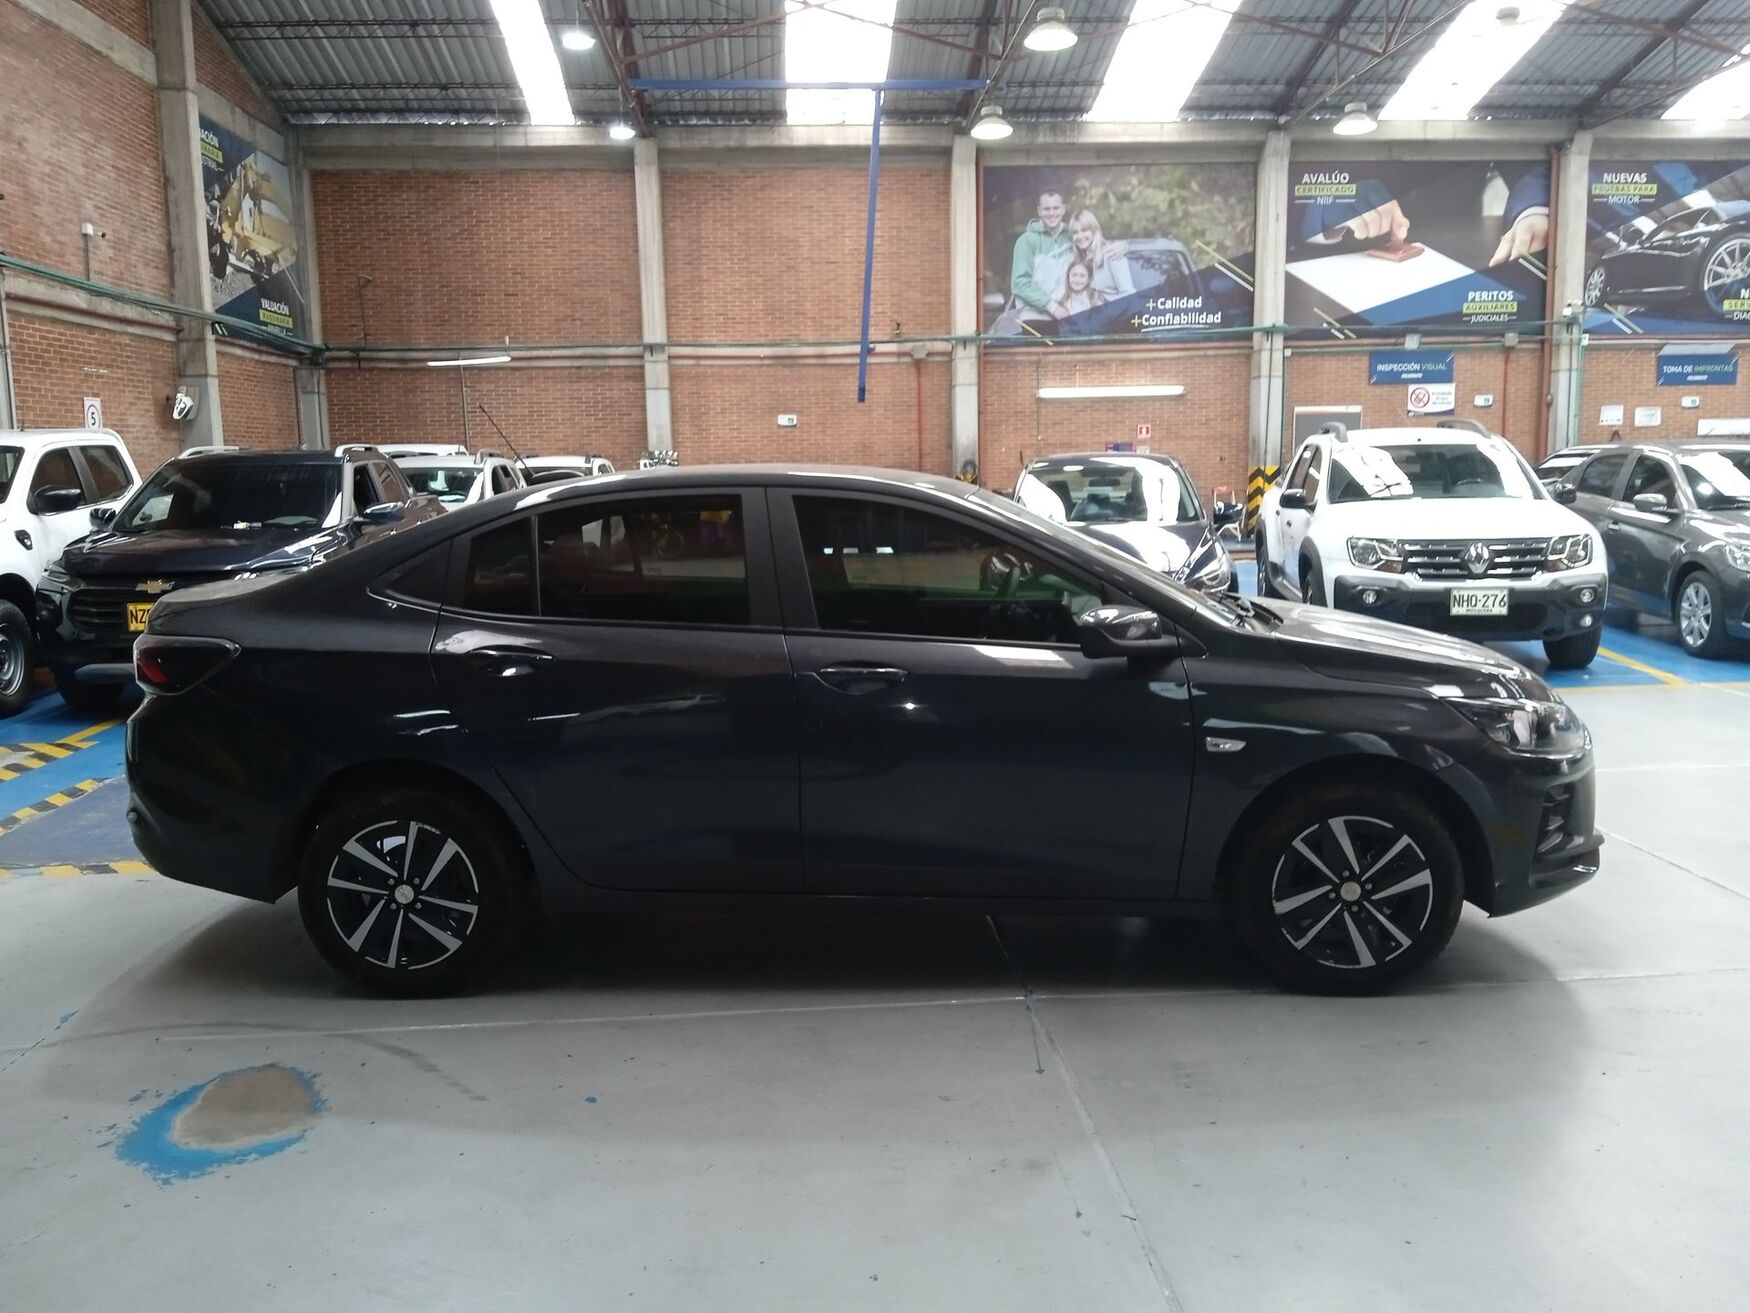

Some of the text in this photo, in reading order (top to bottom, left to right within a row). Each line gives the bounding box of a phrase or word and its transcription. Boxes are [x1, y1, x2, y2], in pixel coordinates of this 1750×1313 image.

[1301, 169, 1350, 185] AVALÚO
[1602, 171, 1648, 184] NUEVAS
[1296, 186, 1354, 194] CERTIFICADO
[1633, 185, 1655, 193] PARA
[1316, 196, 1334, 205] NIIF
[1607, 194, 1641, 205] MOTOR
[1467, 290, 1514, 302] PERITOS
[260, 297, 290, 316] VALUACIÓN
[1465, 303, 1515, 311] AUXILIARES
[1470, 313, 1509, 324] JUDICIALES
[1376, 361, 1448, 372] INSPECCIÓN VISUAL
[1663, 365, 1683, 373] TOMA
[1683, 364, 1693, 373] DE
[90, 411, 97, 426] 5
[130, 608, 150, 624] NZ
